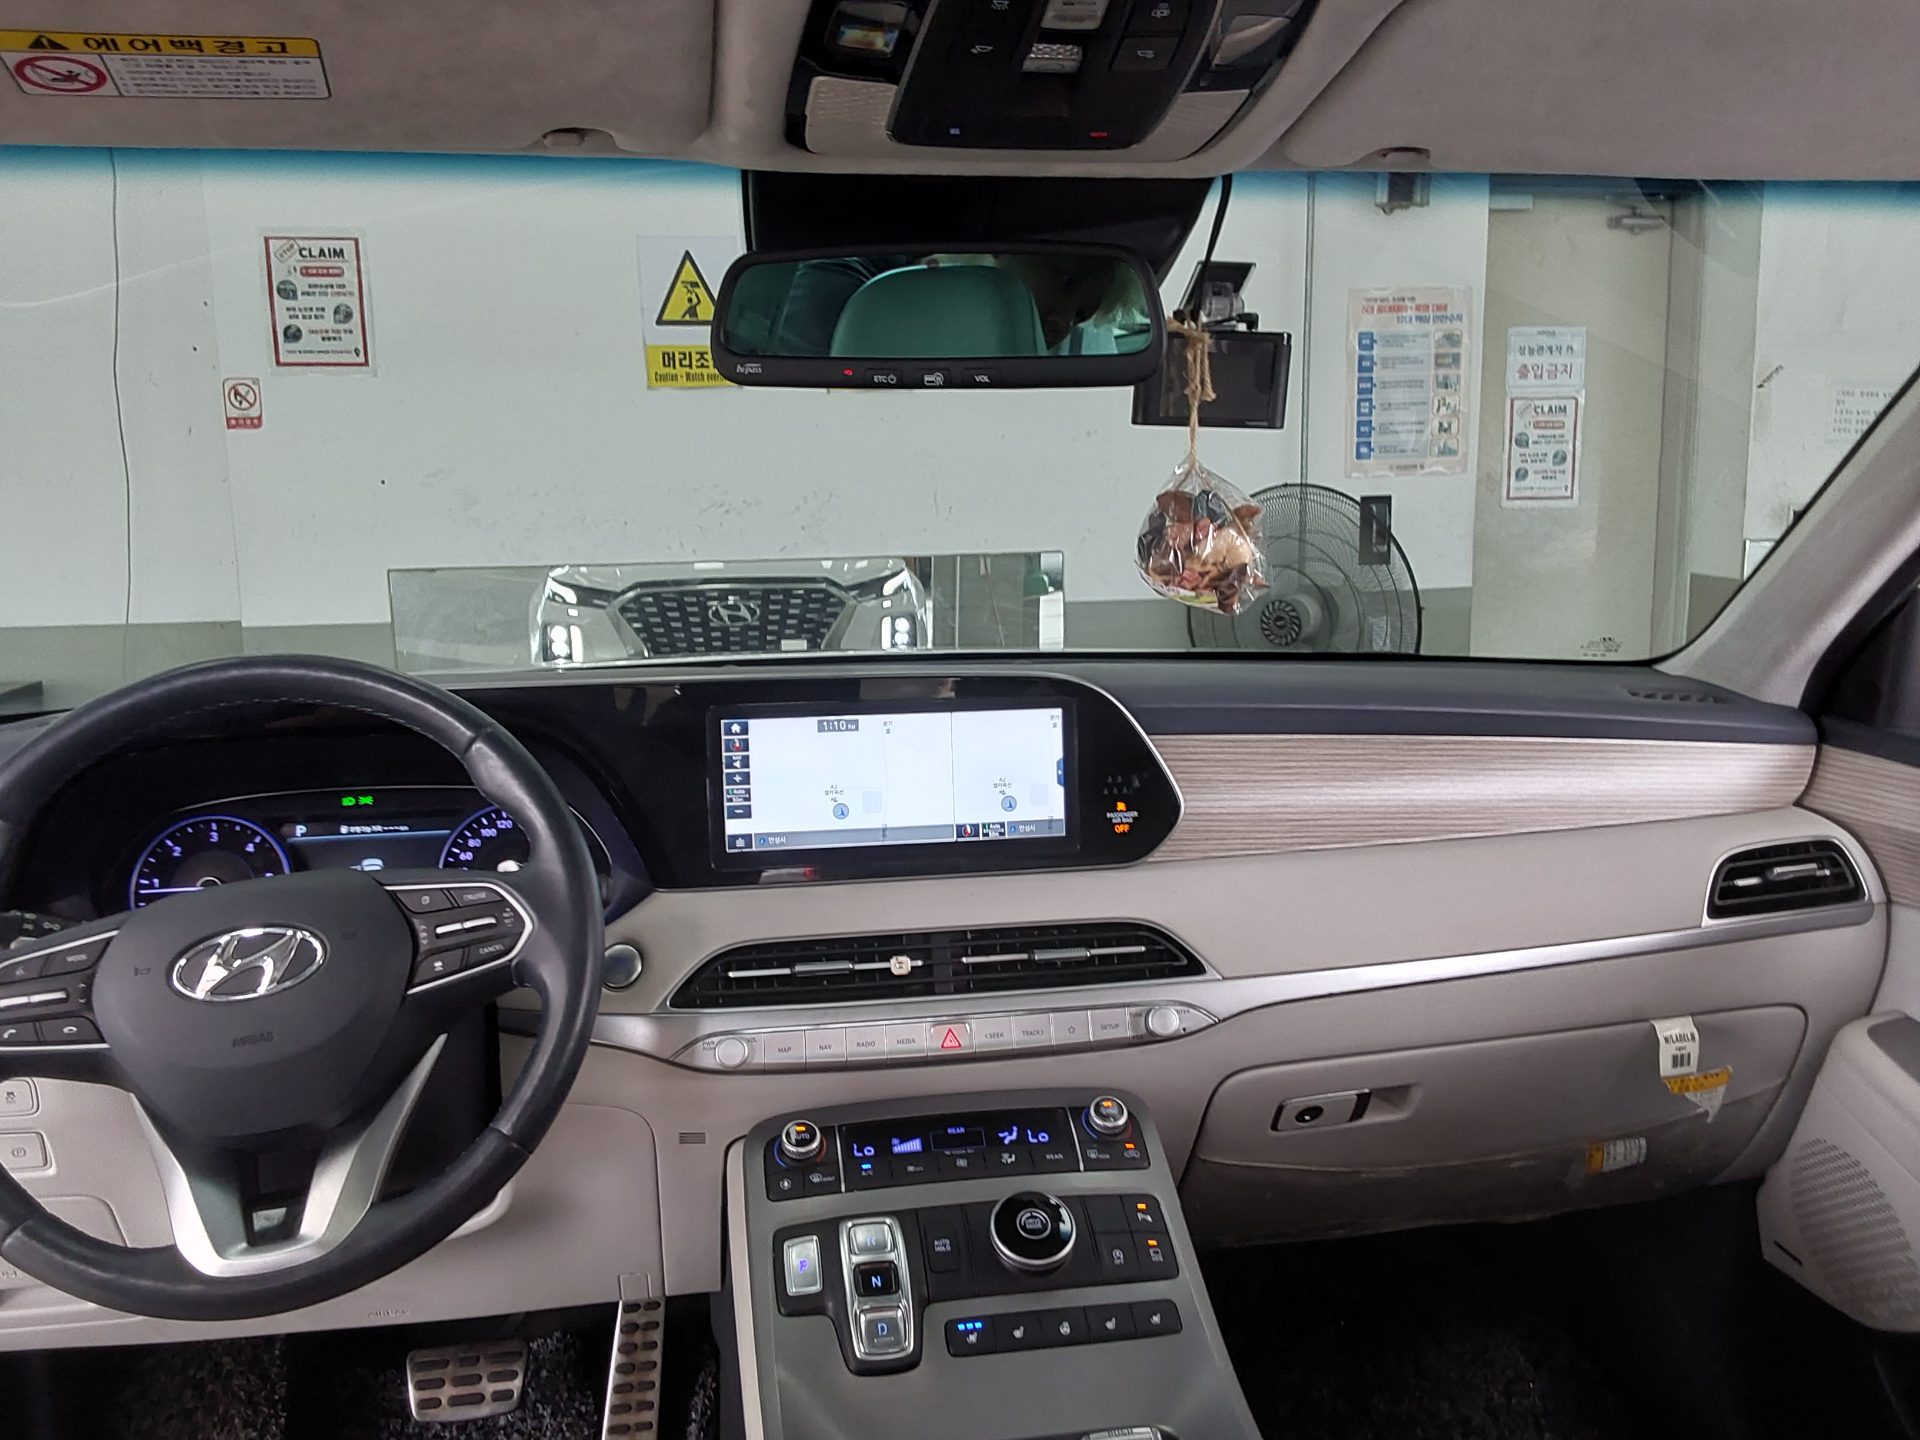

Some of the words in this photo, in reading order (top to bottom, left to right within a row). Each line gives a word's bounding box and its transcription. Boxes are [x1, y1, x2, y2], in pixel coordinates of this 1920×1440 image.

[299, 246, 345, 259] CLAIM
[661, 351, 717, 370] 머리조
[1517, 362, 1573, 380] 출입금지
[654, 371, 679, 383] Caution
[685, 371, 705, 383] Watch
[873, 375, 888, 383] ETC
[974, 374, 991, 383] VOL
[1533, 404, 1567, 415] CLAIM
[823, 721, 847, 731] 1:10
[496, 820, 513, 829] 120
[1114, 824, 1130, 833] OFF
[295, 825, 307, 836] P
[480, 828, 497, 838] 100
[209, 831, 219, 842] 3
[245, 842, 255, 853] 4
[467, 838, 482, 848] 80
[172, 846, 182, 857] 2
[459, 851, 474, 861] 60
[152, 878, 160, 888] 1
[479, 944, 504, 954] CANCEL
[1100, 1023, 1120, 1031] SETUP
[947, 1126, 965, 1135] REAR
[1045, 1153, 1064, 1161] REAR
[866, 1235, 875, 1246] R
[933, 1237, 950, 1246] AUTO
[934, 1245, 951, 1253] HOLD
[799, 1259, 809, 1274] P
[871, 1275, 882, 1289] N
[877, 1322, 888, 1336] D
